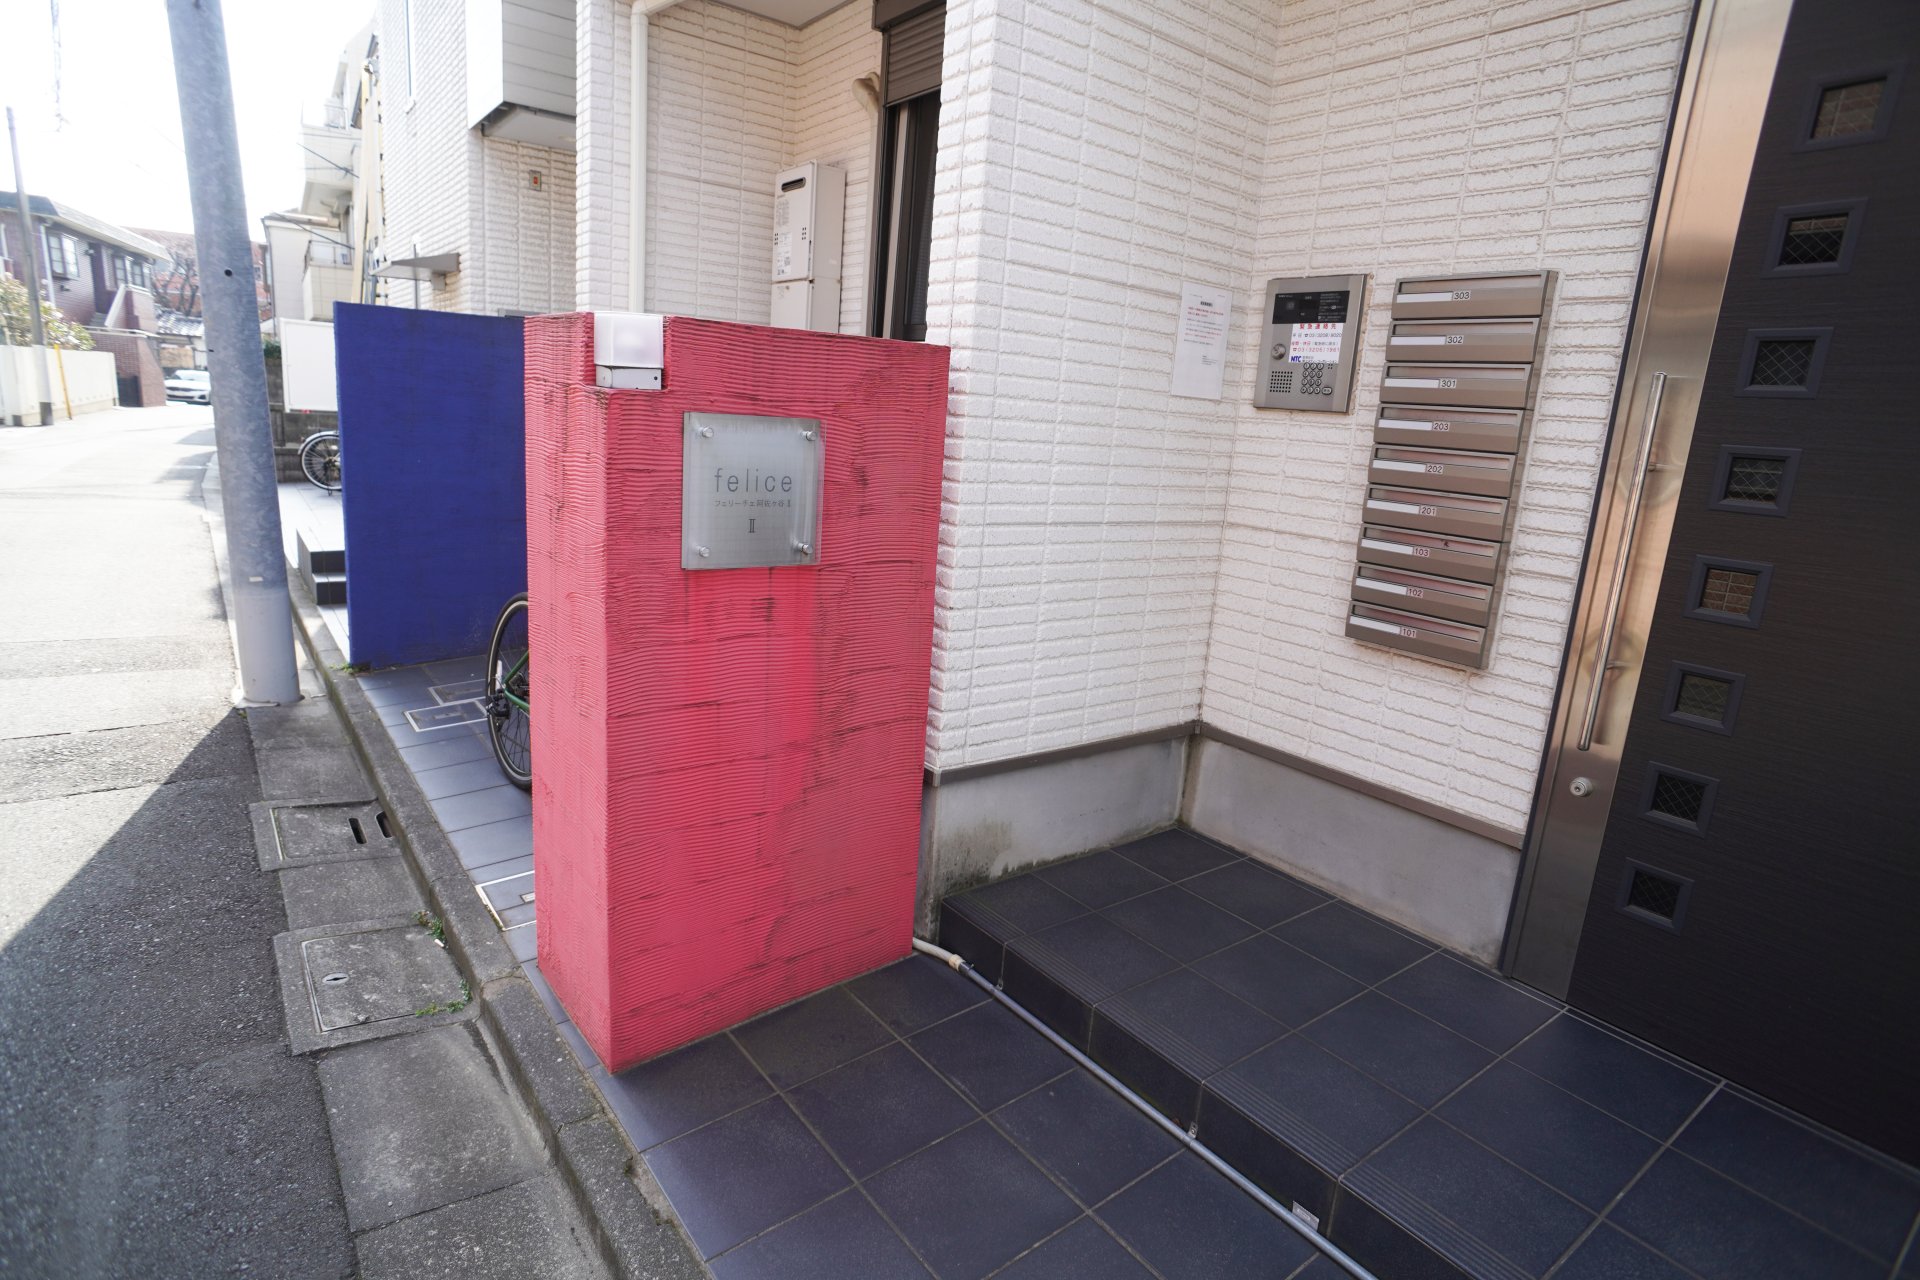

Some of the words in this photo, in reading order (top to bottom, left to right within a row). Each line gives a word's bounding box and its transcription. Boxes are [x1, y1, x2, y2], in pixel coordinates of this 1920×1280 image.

[1454, 292, 1470, 300] 303
[1447, 336, 1463, 344] 302
[1290, 355, 1302, 363] NTC
[1441, 380, 1456, 388] 301
[1433, 423, 1449, 431] 203
[1427, 465, 1443, 473] 202
[714, 467, 792, 493] felice
[1421, 507, 1436, 515] 201
[1415, 548, 1429, 557] 103
[1409, 588, 1422, 597] 102
[1402, 628, 1416, 637] 101
